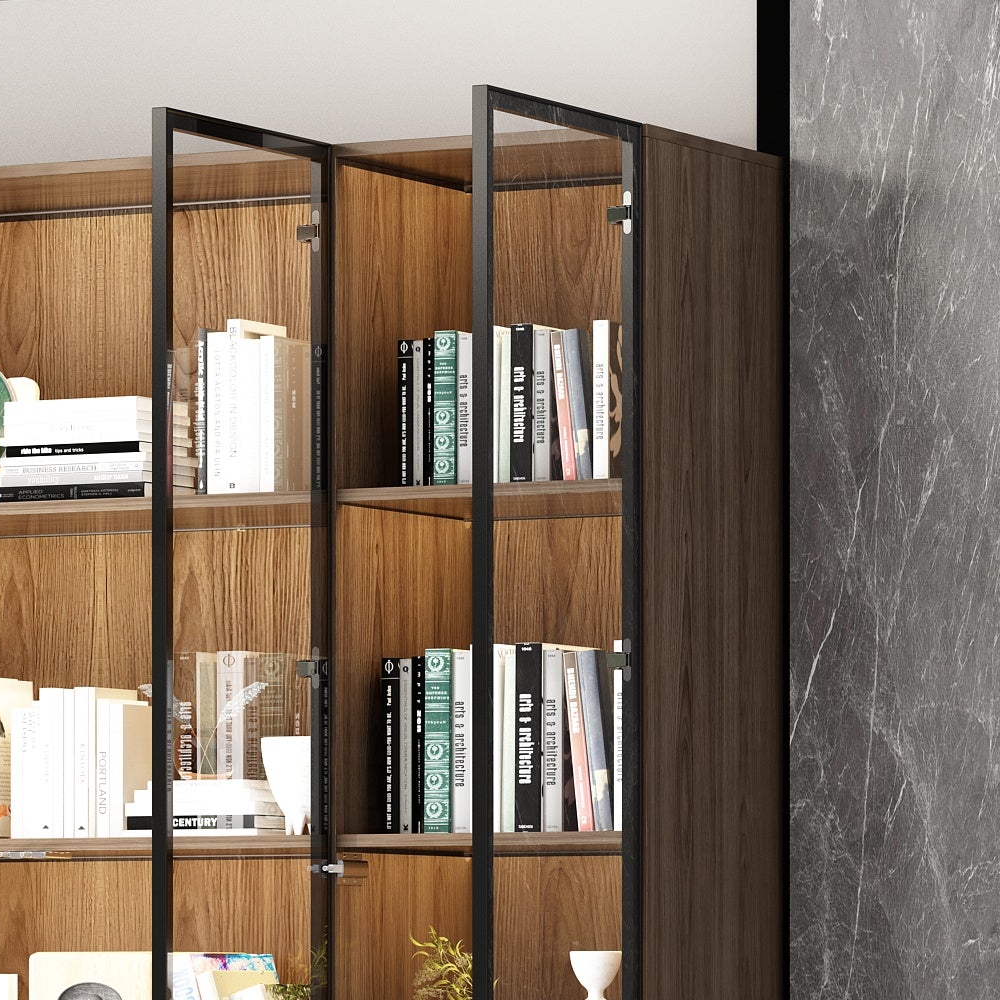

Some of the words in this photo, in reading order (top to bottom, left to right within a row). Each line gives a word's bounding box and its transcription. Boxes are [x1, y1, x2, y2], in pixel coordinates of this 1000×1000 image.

[460, 375, 468, 389] arts
[513, 366, 526, 383] arts
[536, 371, 546, 385] arts
[595, 364, 604, 379] arts
[460, 402, 470, 447] architecture
[513, 395, 527, 443] architecture
[536, 398, 547, 444] architecture
[595, 392, 605, 439] architecture
[229, 417, 237, 458] DESIGN
[22, 466, 57, 474] BUSINESS
[58, 465, 97, 473] RESEARCH
[455, 701, 465, 718] arts
[519, 694, 532, 713] arts
[546, 699, 556, 717] arts
[455, 733, 467, 787] architecture
[519, 727, 534, 784] architecture
[546, 731, 558, 786] architecture
[98, 751, 107, 815] PORTLAND
[173, 817, 218, 828] CENTURY
